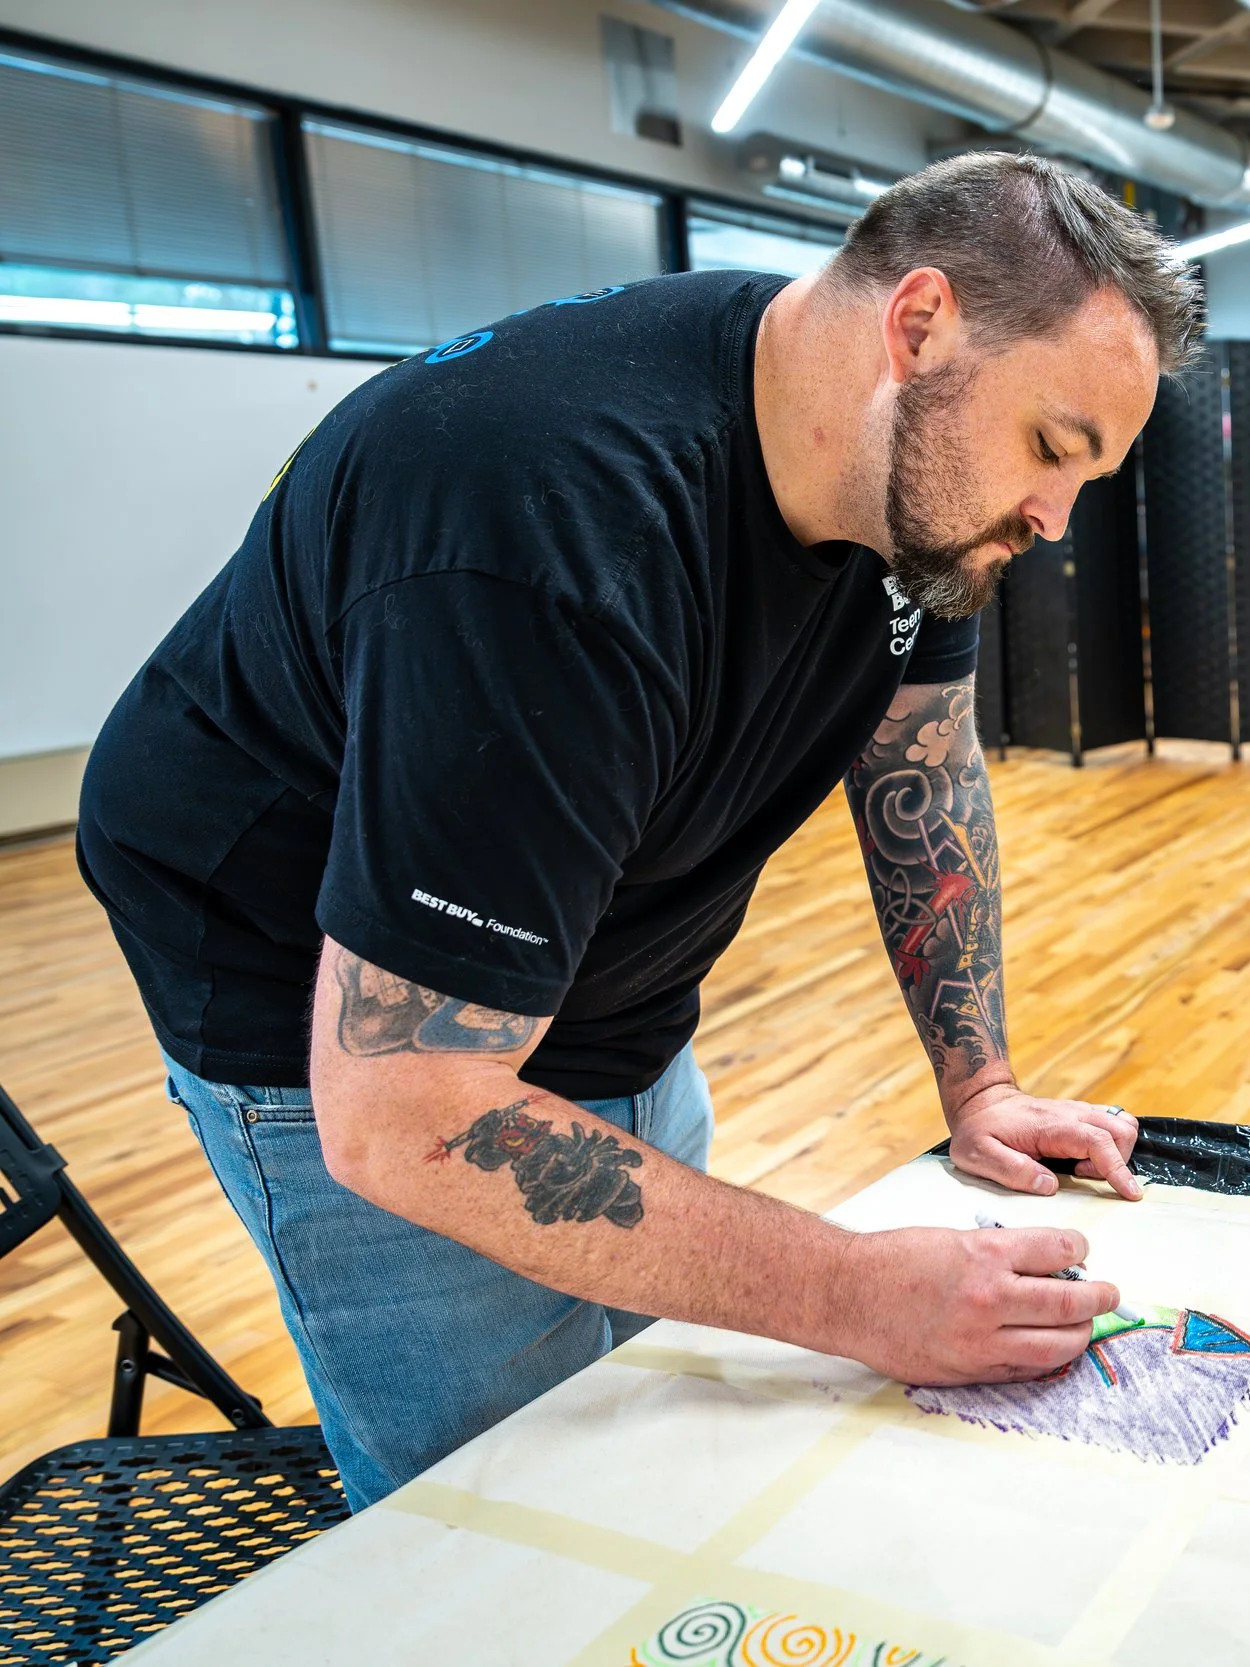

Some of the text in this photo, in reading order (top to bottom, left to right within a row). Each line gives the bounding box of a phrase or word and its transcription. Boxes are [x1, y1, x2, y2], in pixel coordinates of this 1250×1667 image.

[889, 608, 921, 635] Teen
[411, 888, 448, 911] BEST
[446, 903, 478, 922] BUY
